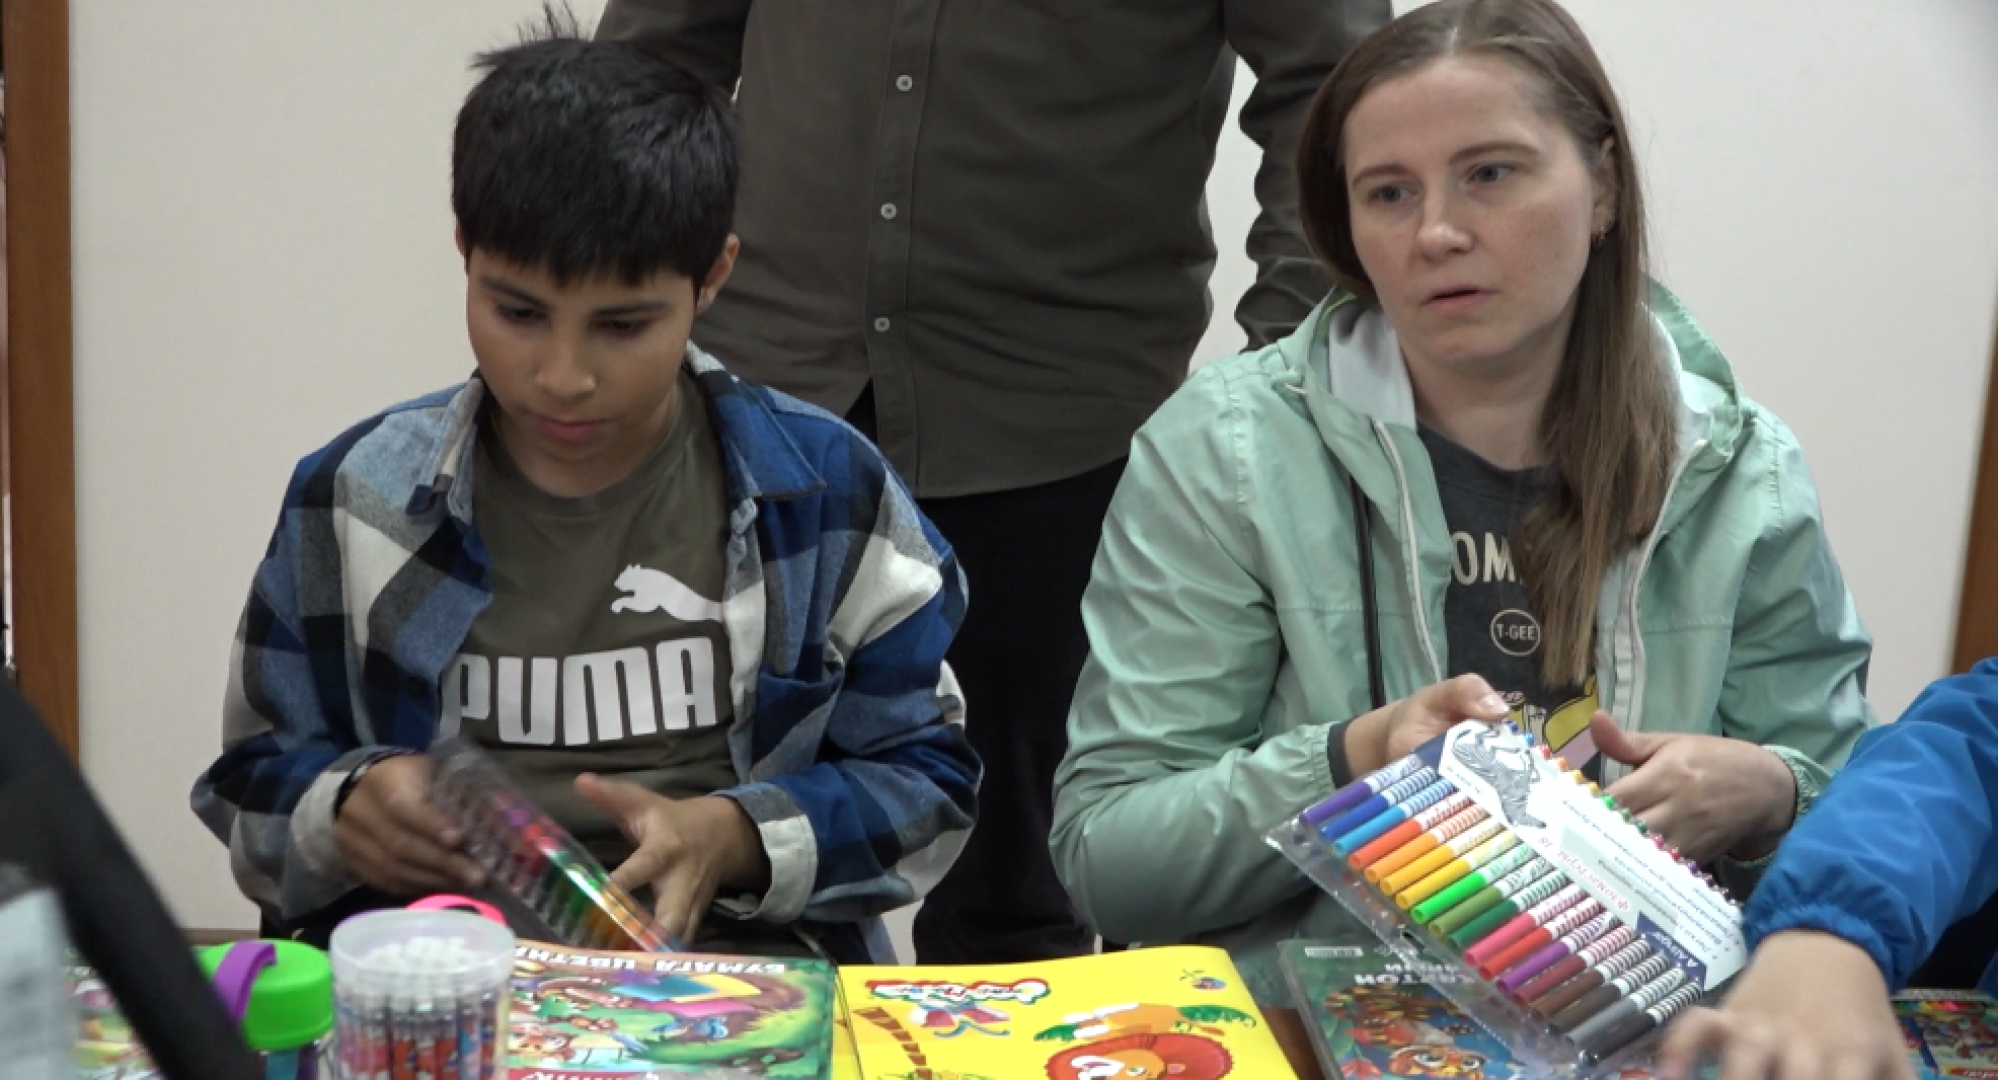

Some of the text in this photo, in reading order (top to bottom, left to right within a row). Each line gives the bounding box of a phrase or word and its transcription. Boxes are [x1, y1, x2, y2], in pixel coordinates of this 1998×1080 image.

[1452, 531, 1522, 585] OM
[1496, 623, 1537, 641] T-GEE
[438, 637, 717, 746] PUMA
[656, 959, 785, 973] БУМАГА
